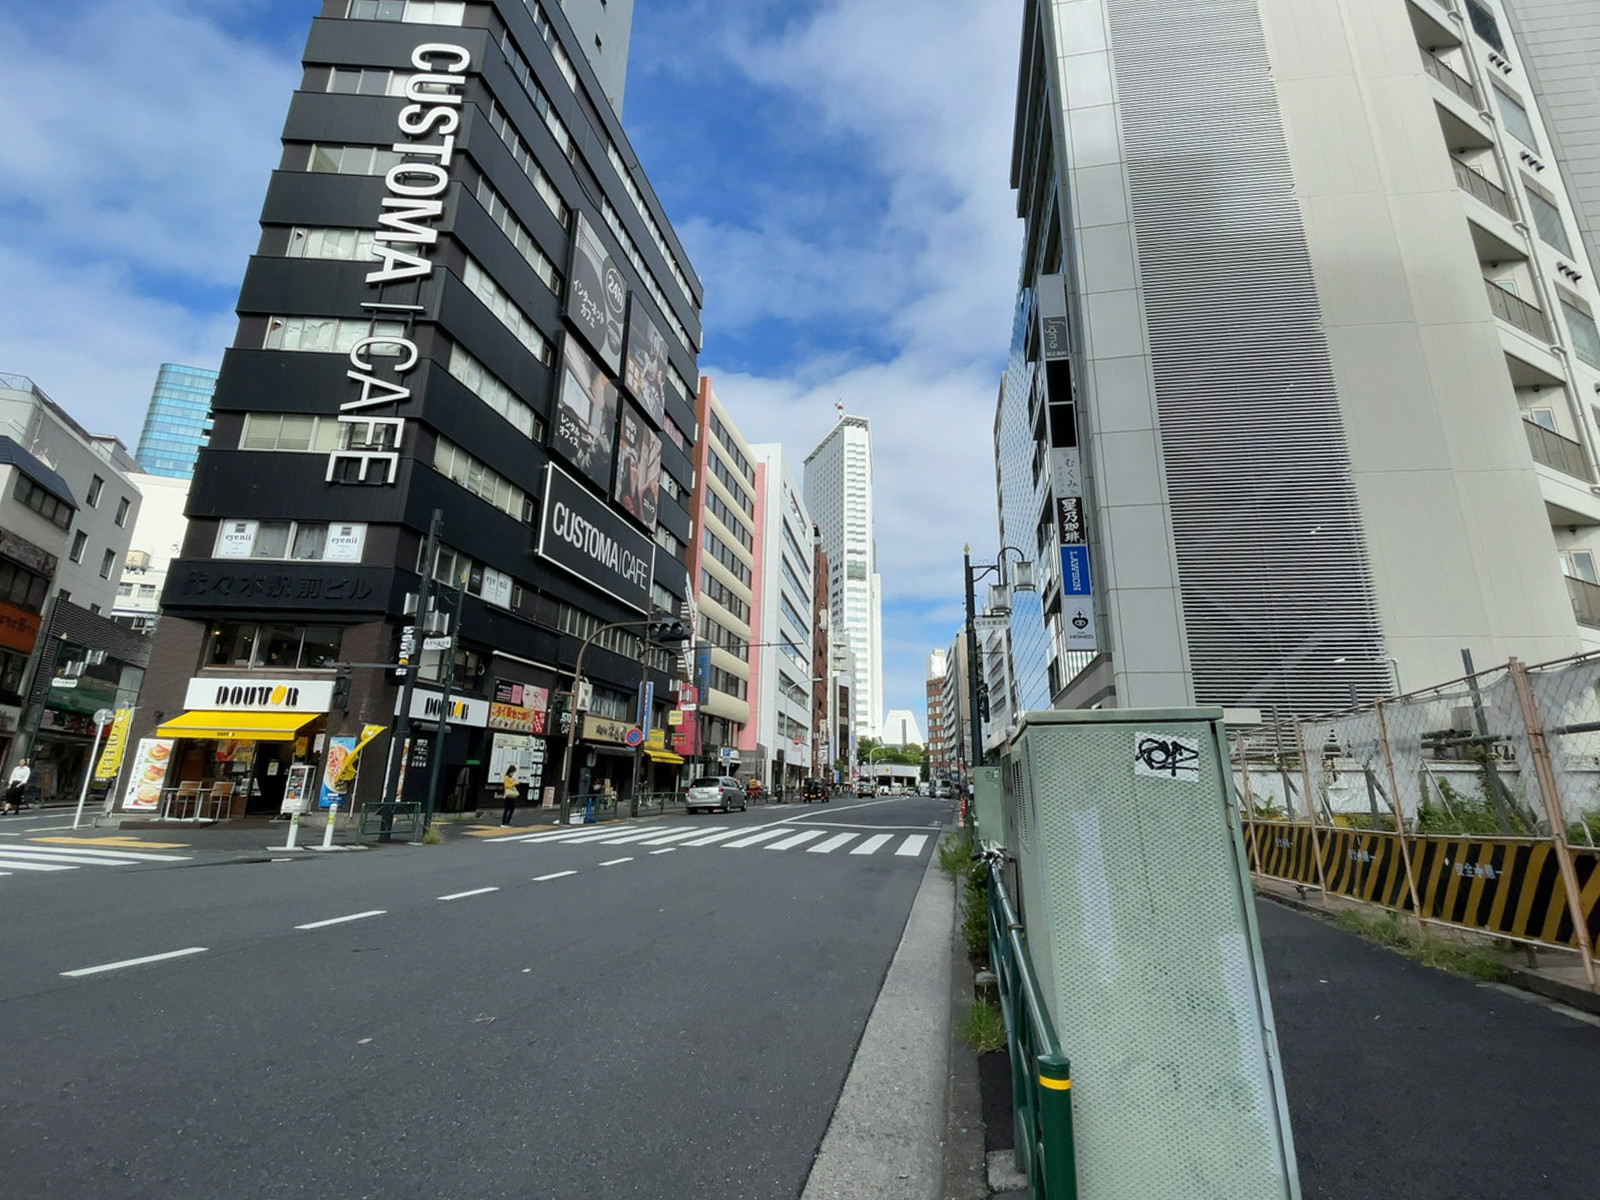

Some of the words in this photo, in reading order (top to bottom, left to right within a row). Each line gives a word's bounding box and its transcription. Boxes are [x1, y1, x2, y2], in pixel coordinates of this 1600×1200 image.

[364, 42, 472, 284] CUSTOMA
[324, 335, 419, 485] CAFE
[552, 500, 619, 573] CUSTOMA
[621, 548, 649, 591] CAFE
[182, 568, 373, 601] 代々木駅前ビル
[1069, 550, 1082, 592] LAWSON
[215, 685, 299, 707] DOUTOR
[425, 697, 470, 721] DOTOR
